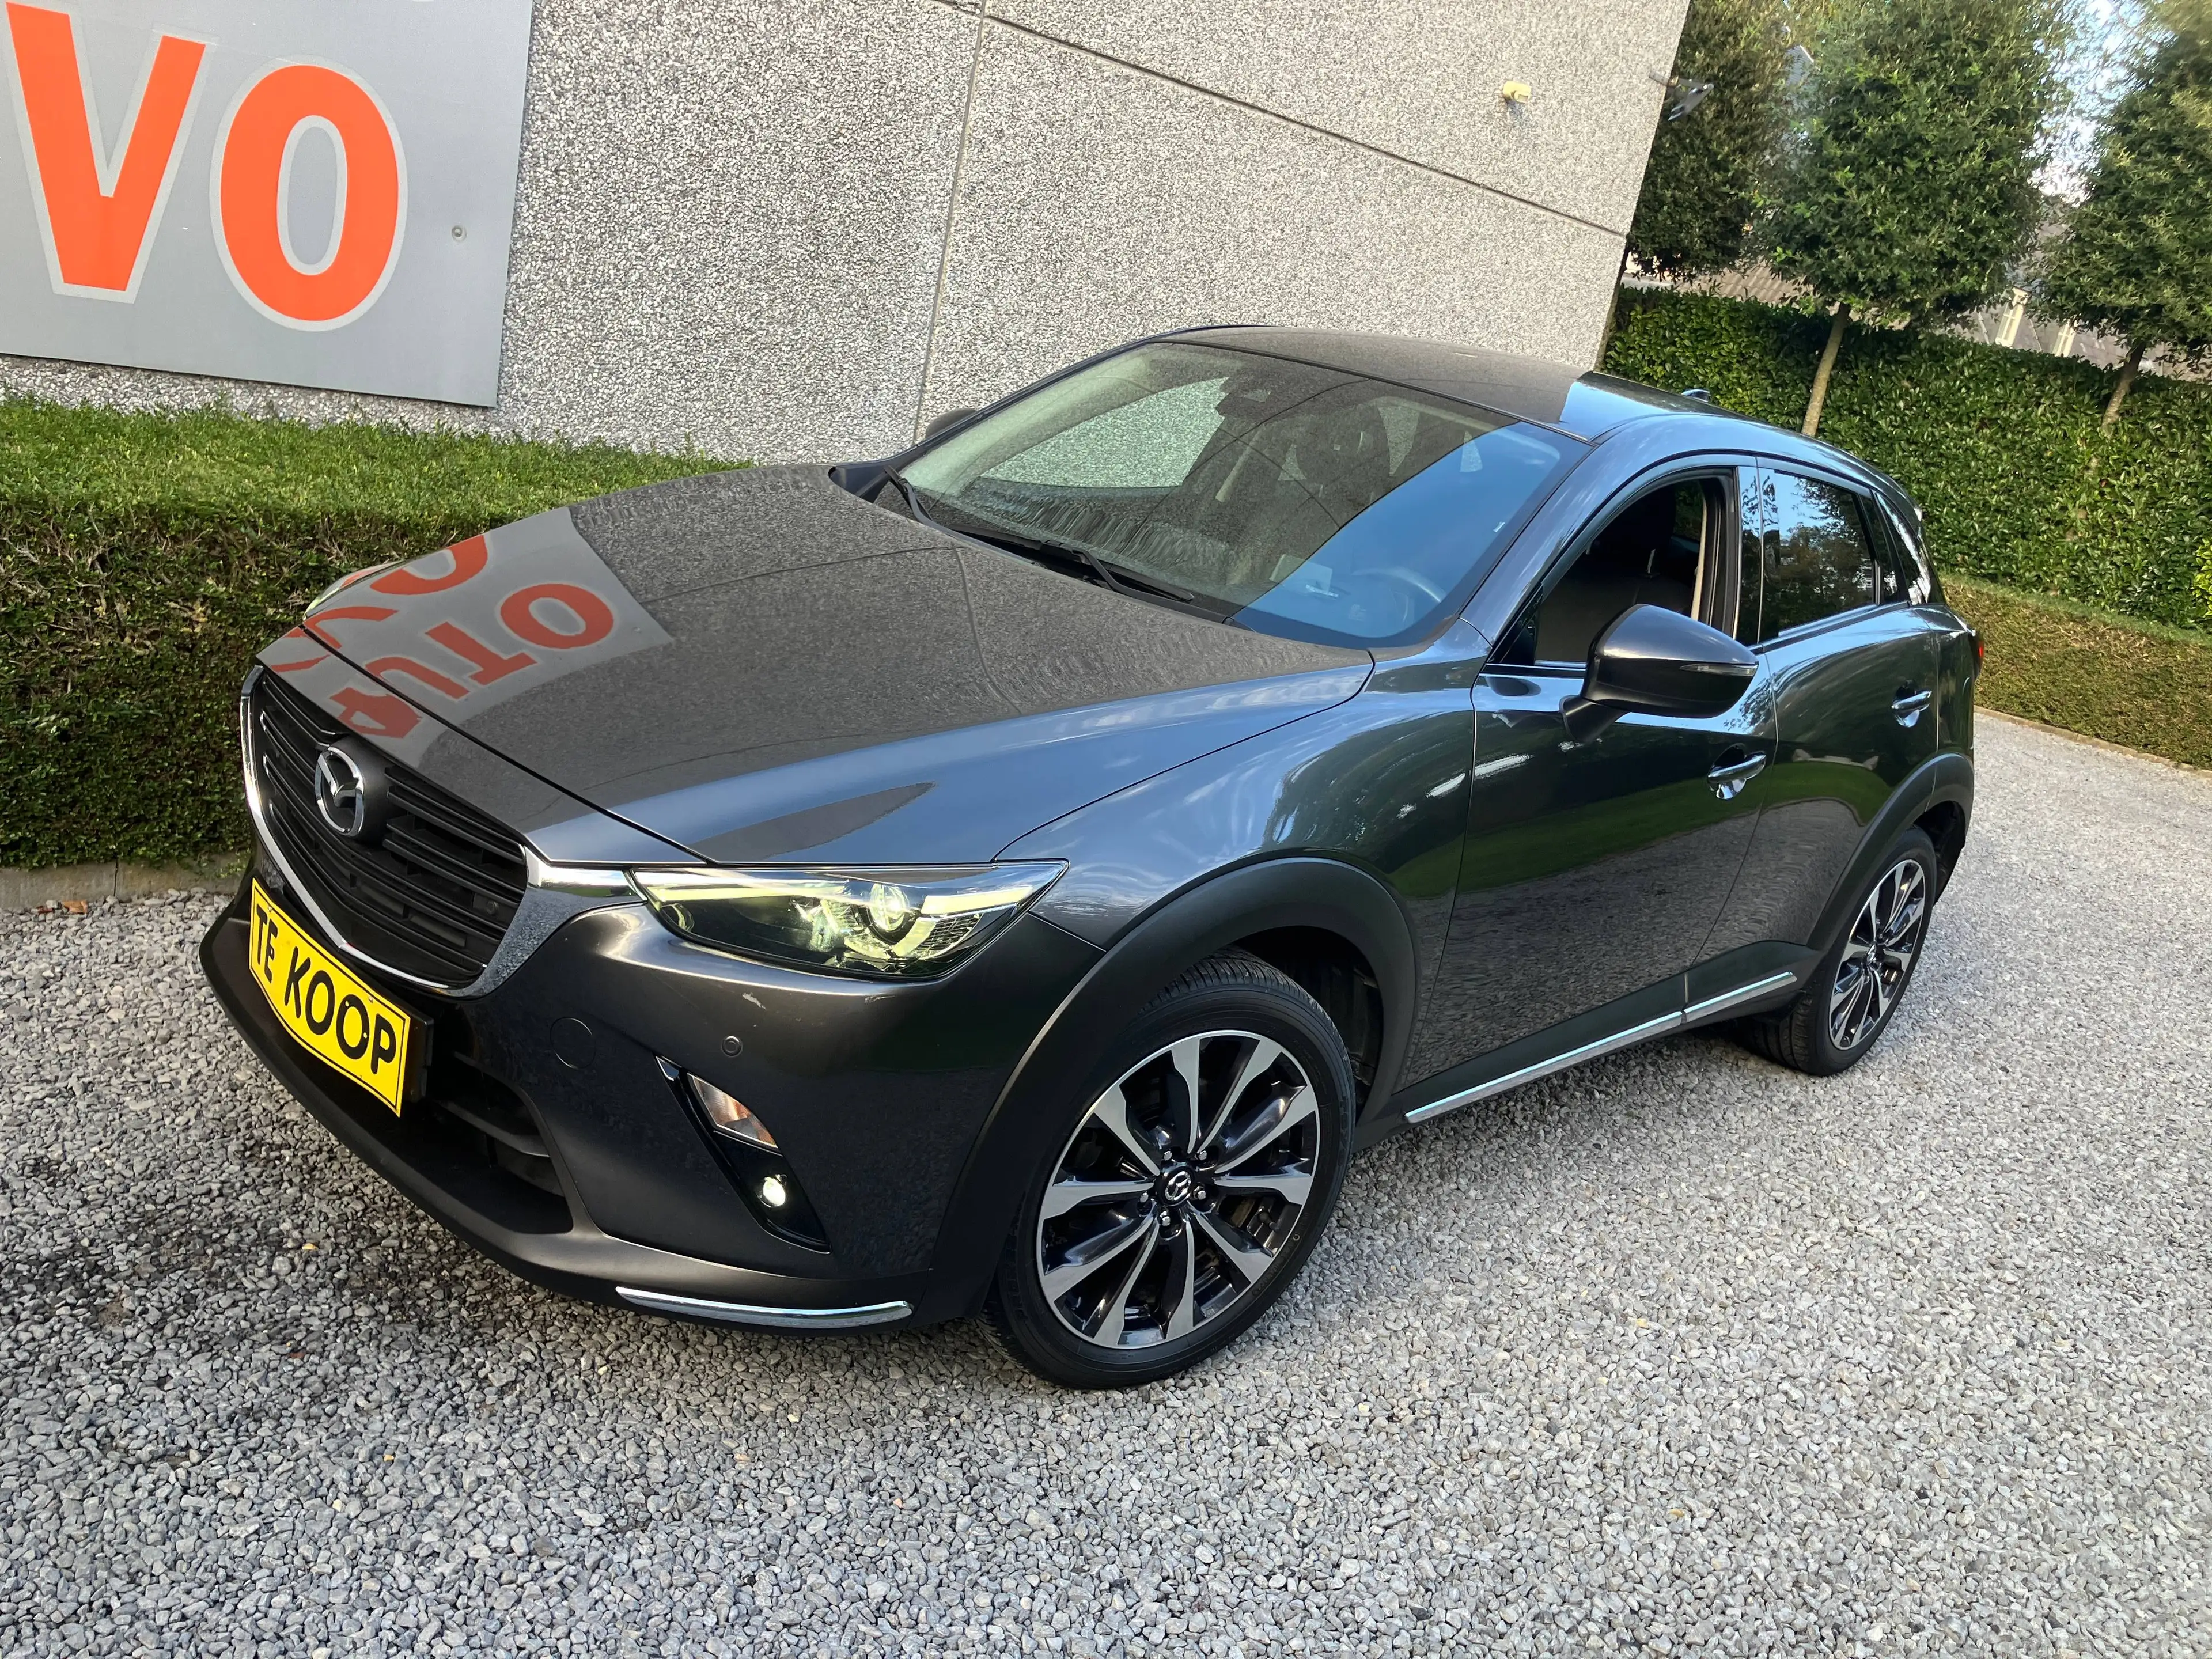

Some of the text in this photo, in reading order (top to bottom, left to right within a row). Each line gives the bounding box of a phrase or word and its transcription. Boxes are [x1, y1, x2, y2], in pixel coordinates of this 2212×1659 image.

[2, 1, 403, 326] VO
[256, 903, 397, 1075] TE KOOP
